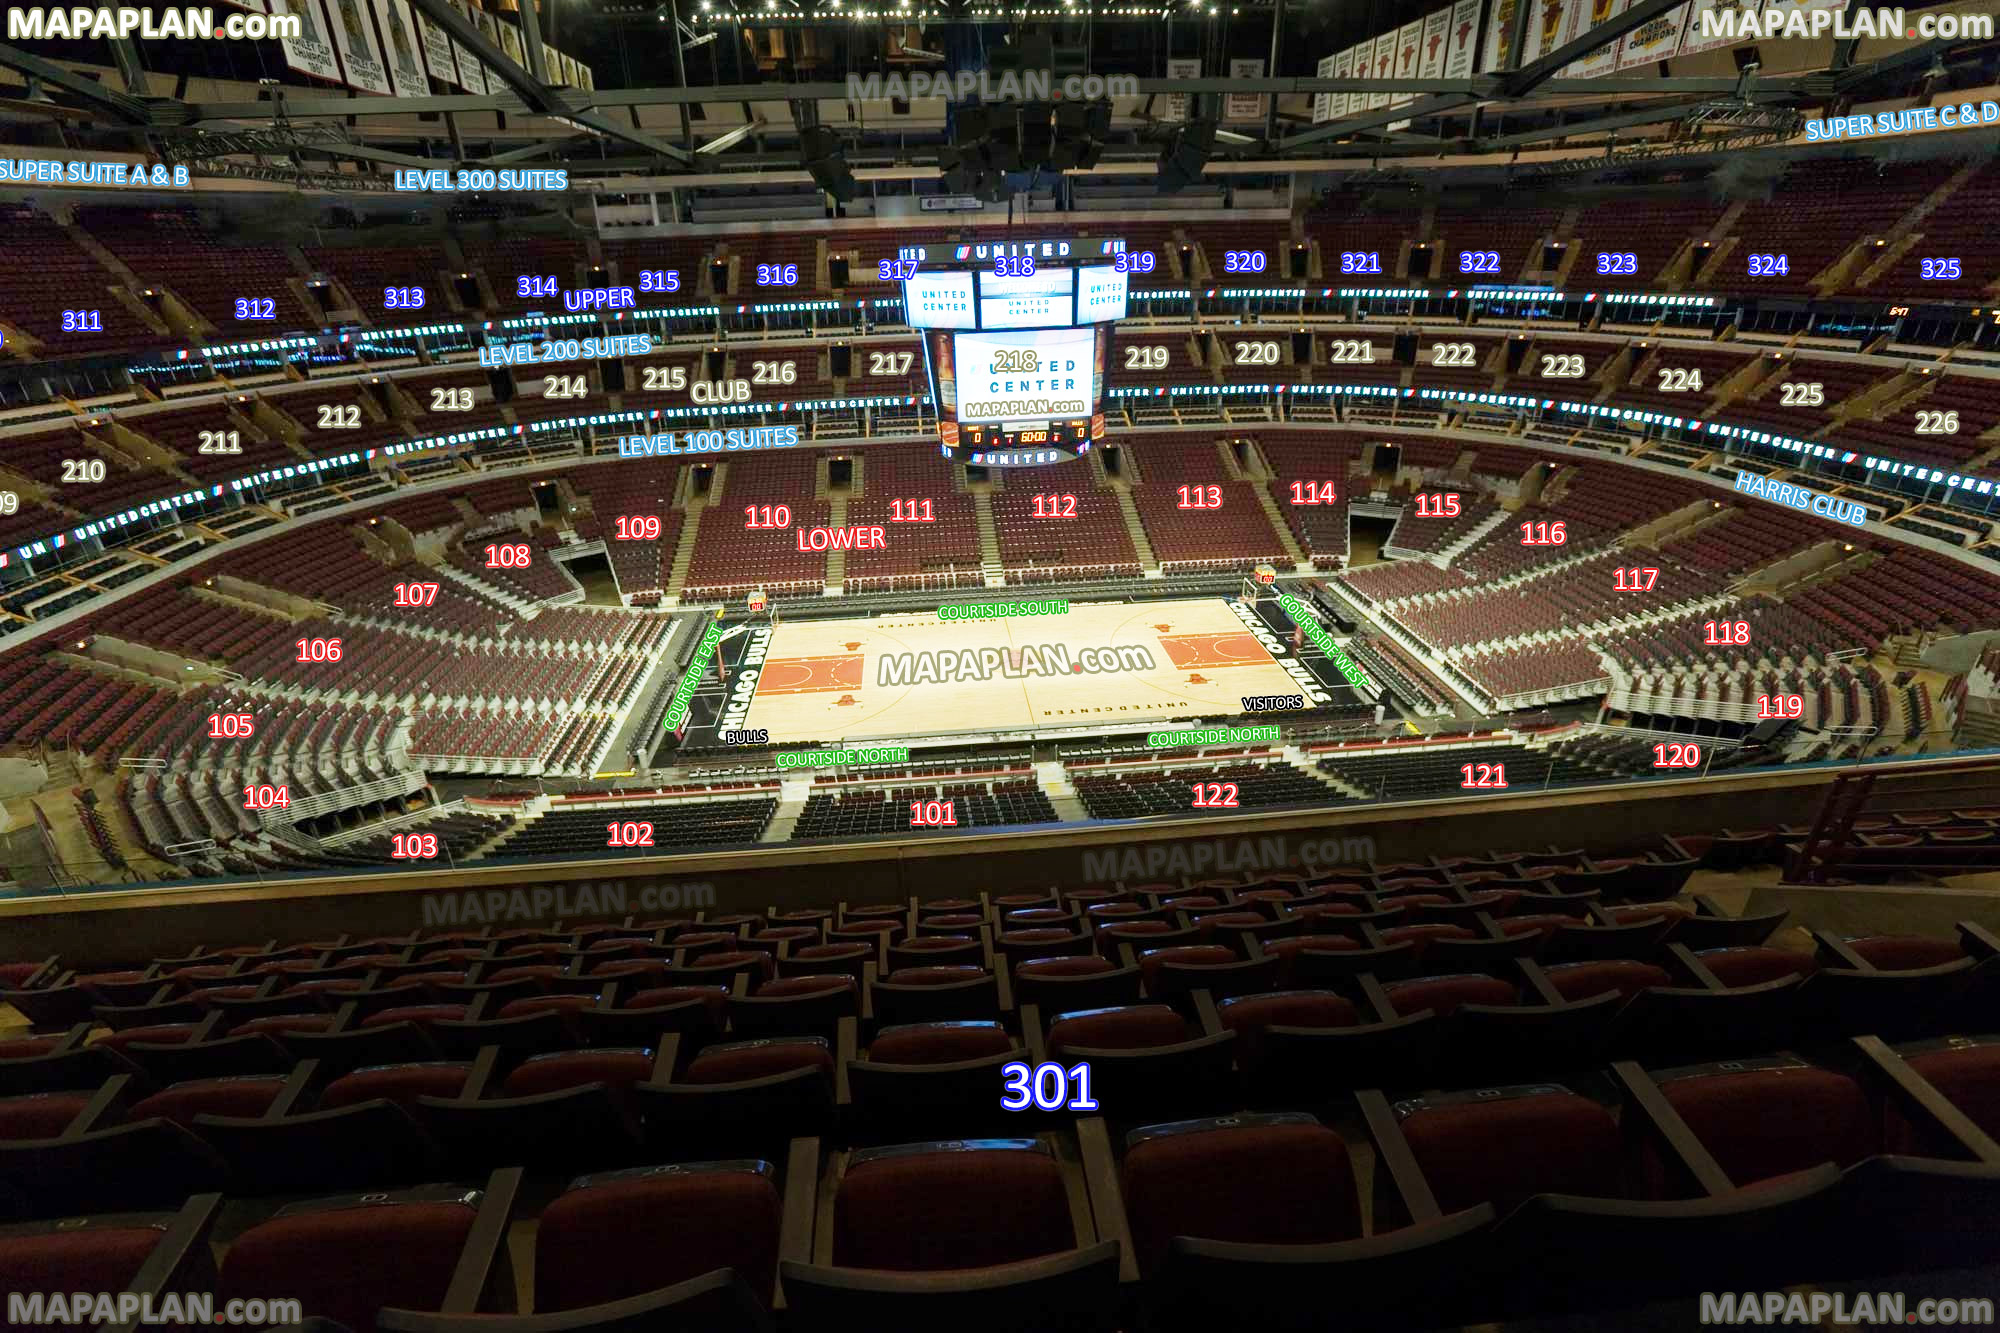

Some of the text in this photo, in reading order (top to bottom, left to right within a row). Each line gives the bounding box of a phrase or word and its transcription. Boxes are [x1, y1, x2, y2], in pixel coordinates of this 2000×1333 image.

[976, 242, 1070, 258] UNITED
[922, 291, 966, 299] UNITED
[1090, 283, 1123, 294] UNITED
[923, 303, 967, 311] CENTER
[1008, 299, 1050, 307] UNITED
[1090, 295, 1122, 306] CENTER
[989, 360, 1075, 375] UTED
[989, 379, 1075, 393] CENTER
[987, 451, 1058, 465] UNITED
[744, 628, 773, 665] BULLS
[1229, 602, 1332, 702] CHICAGO BULLS
